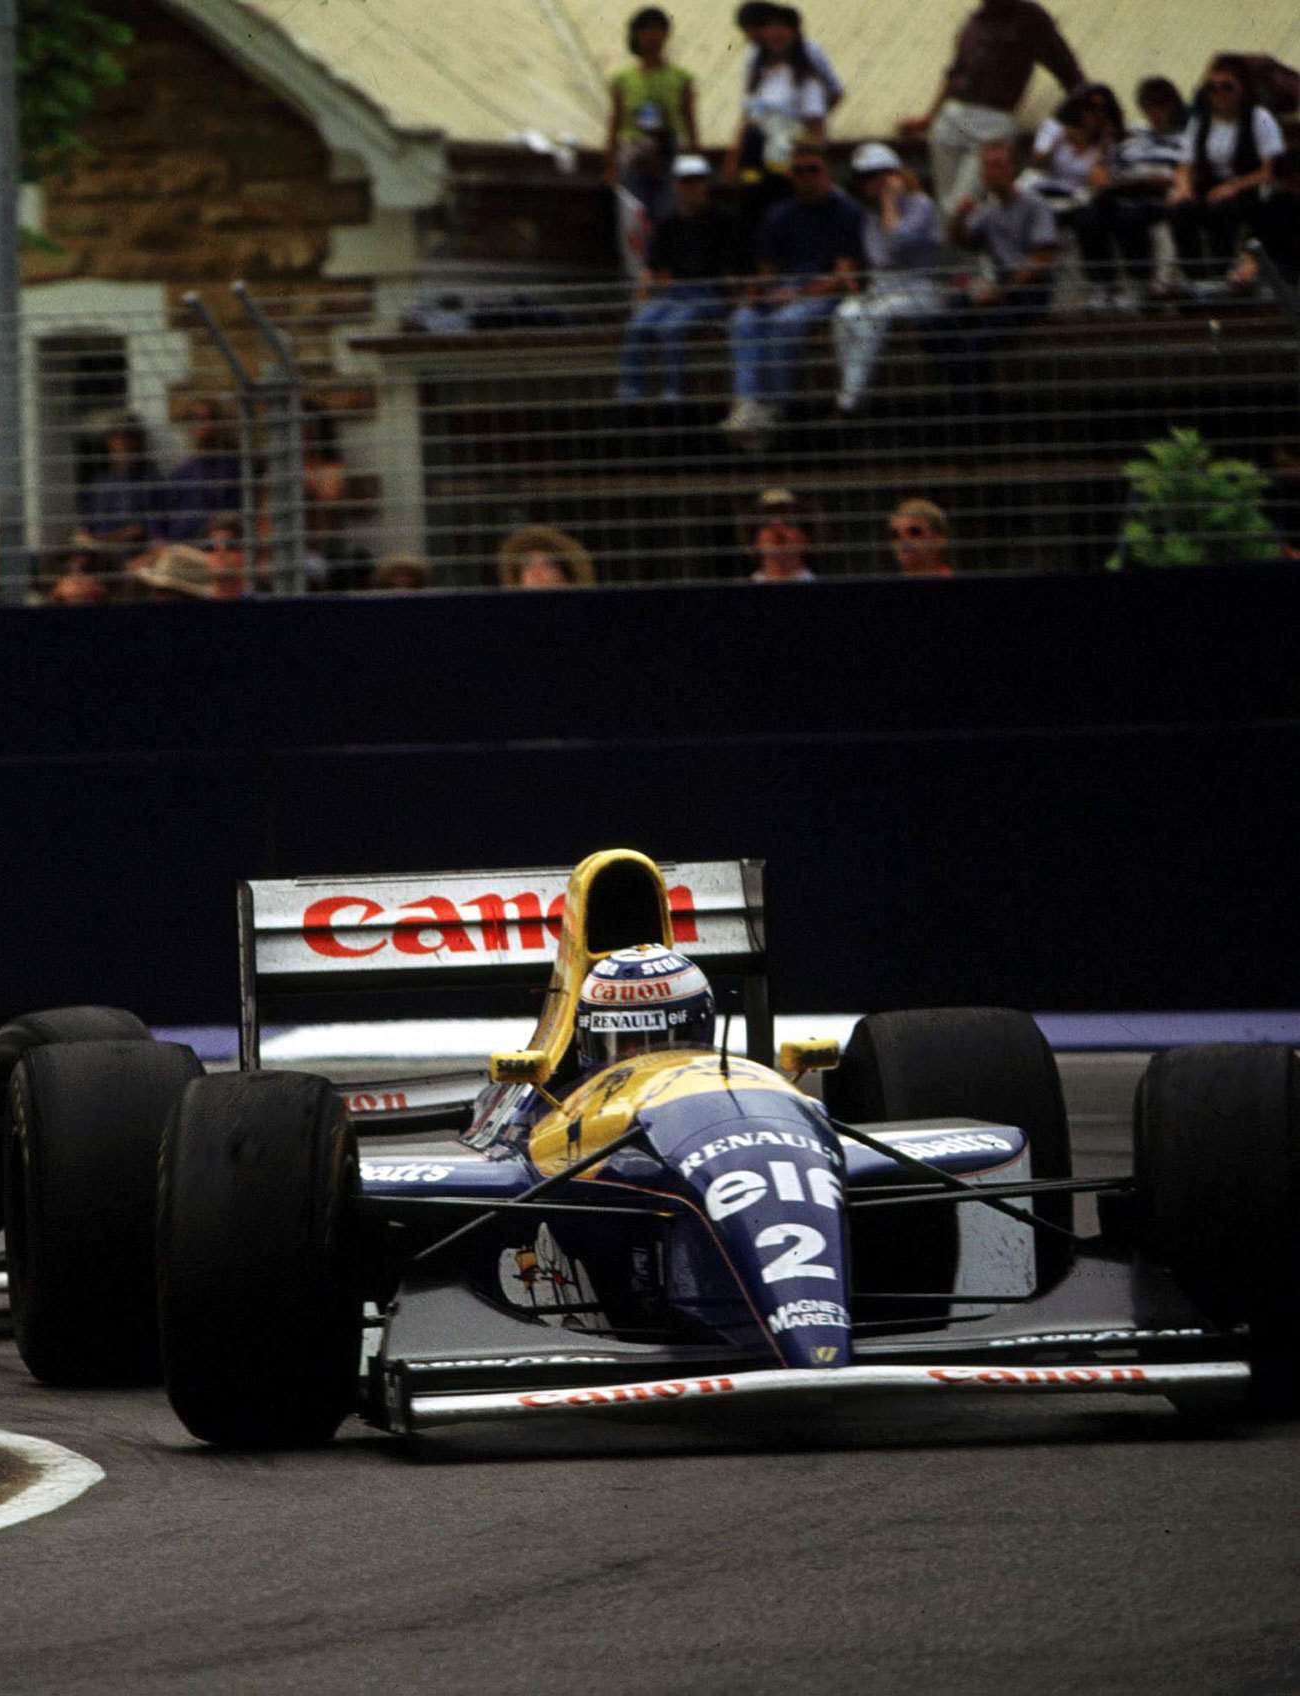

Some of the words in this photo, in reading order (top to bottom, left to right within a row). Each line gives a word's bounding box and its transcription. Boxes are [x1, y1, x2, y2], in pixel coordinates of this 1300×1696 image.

[590, 981, 671, 1001] Canon
[592, 1013, 664, 1030] RENAULT
[754, 1223, 837, 1284] 2
[928, 1367, 1147, 1385] Canon
[518, 1377, 735, 1408] Canon
